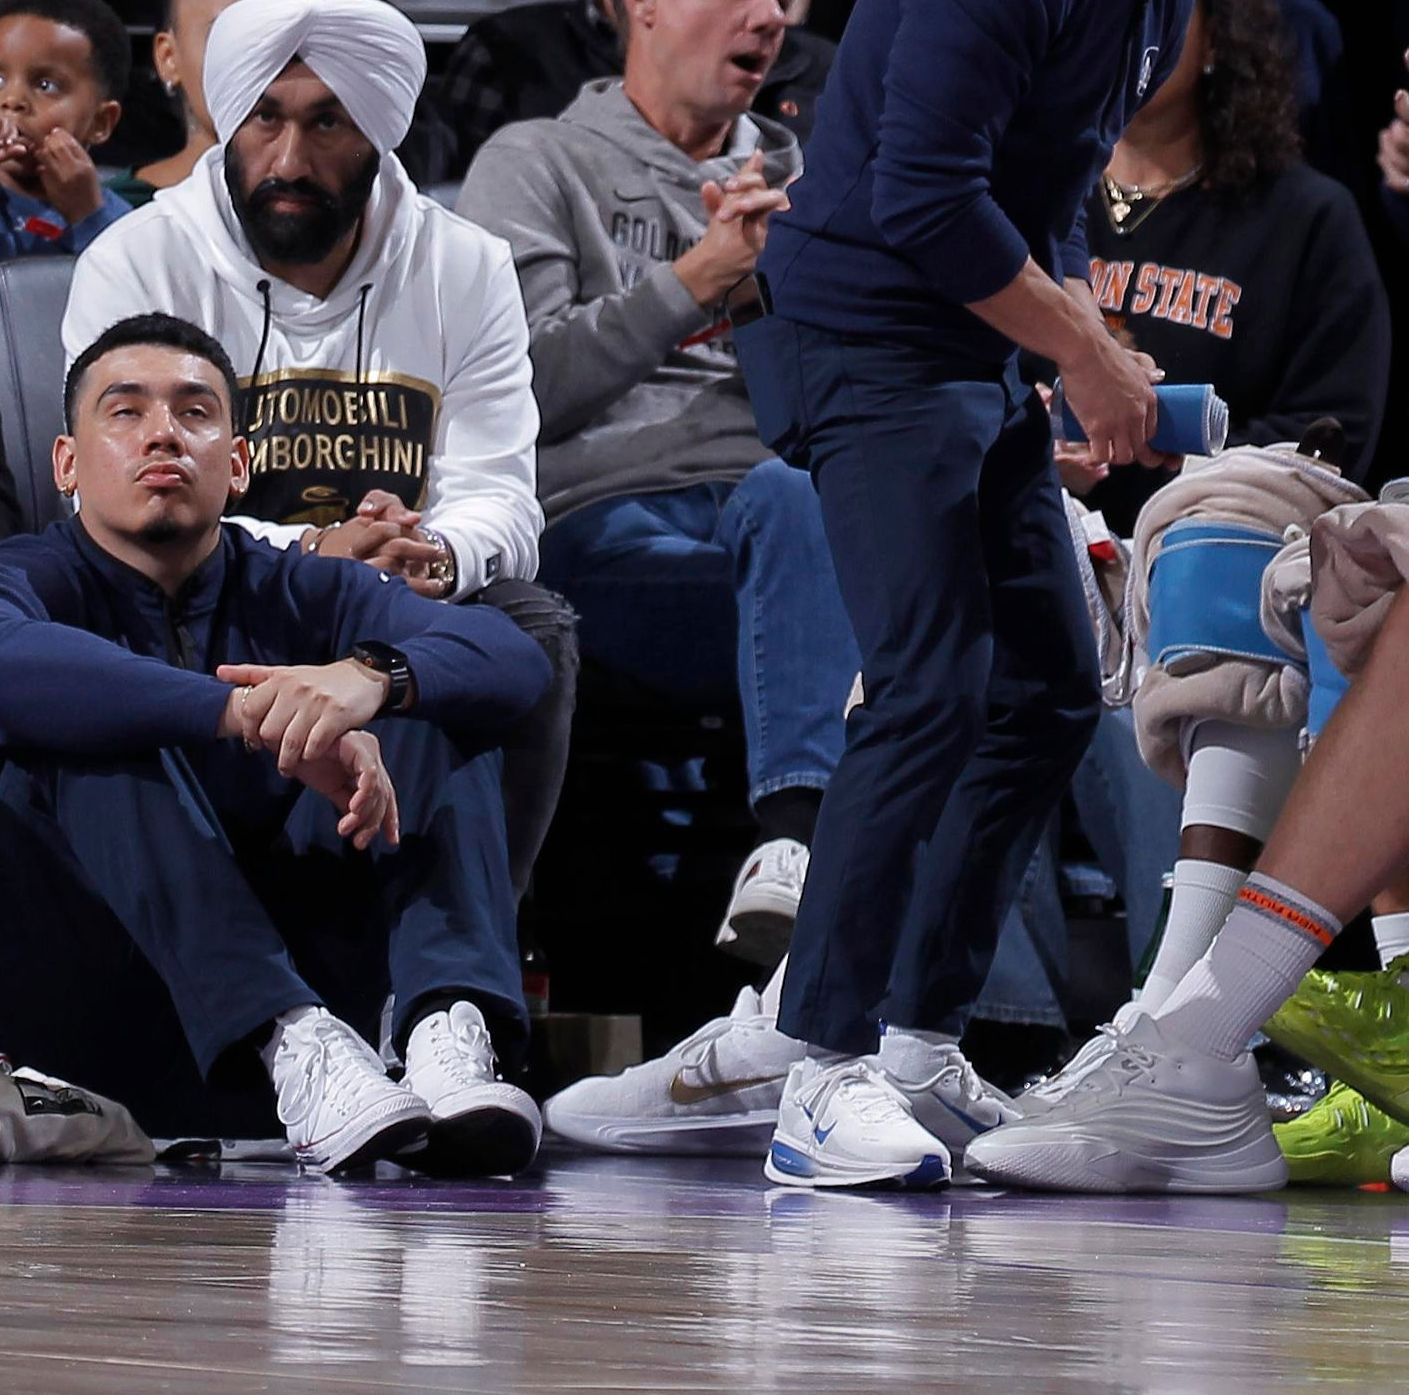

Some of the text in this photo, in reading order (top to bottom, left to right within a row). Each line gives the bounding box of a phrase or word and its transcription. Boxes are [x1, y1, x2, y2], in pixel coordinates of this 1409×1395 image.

[612, 212, 702, 262] GOLD
[1131, 262, 1242, 339] STATE
[236, 387, 409, 433] UTOMOBILI
